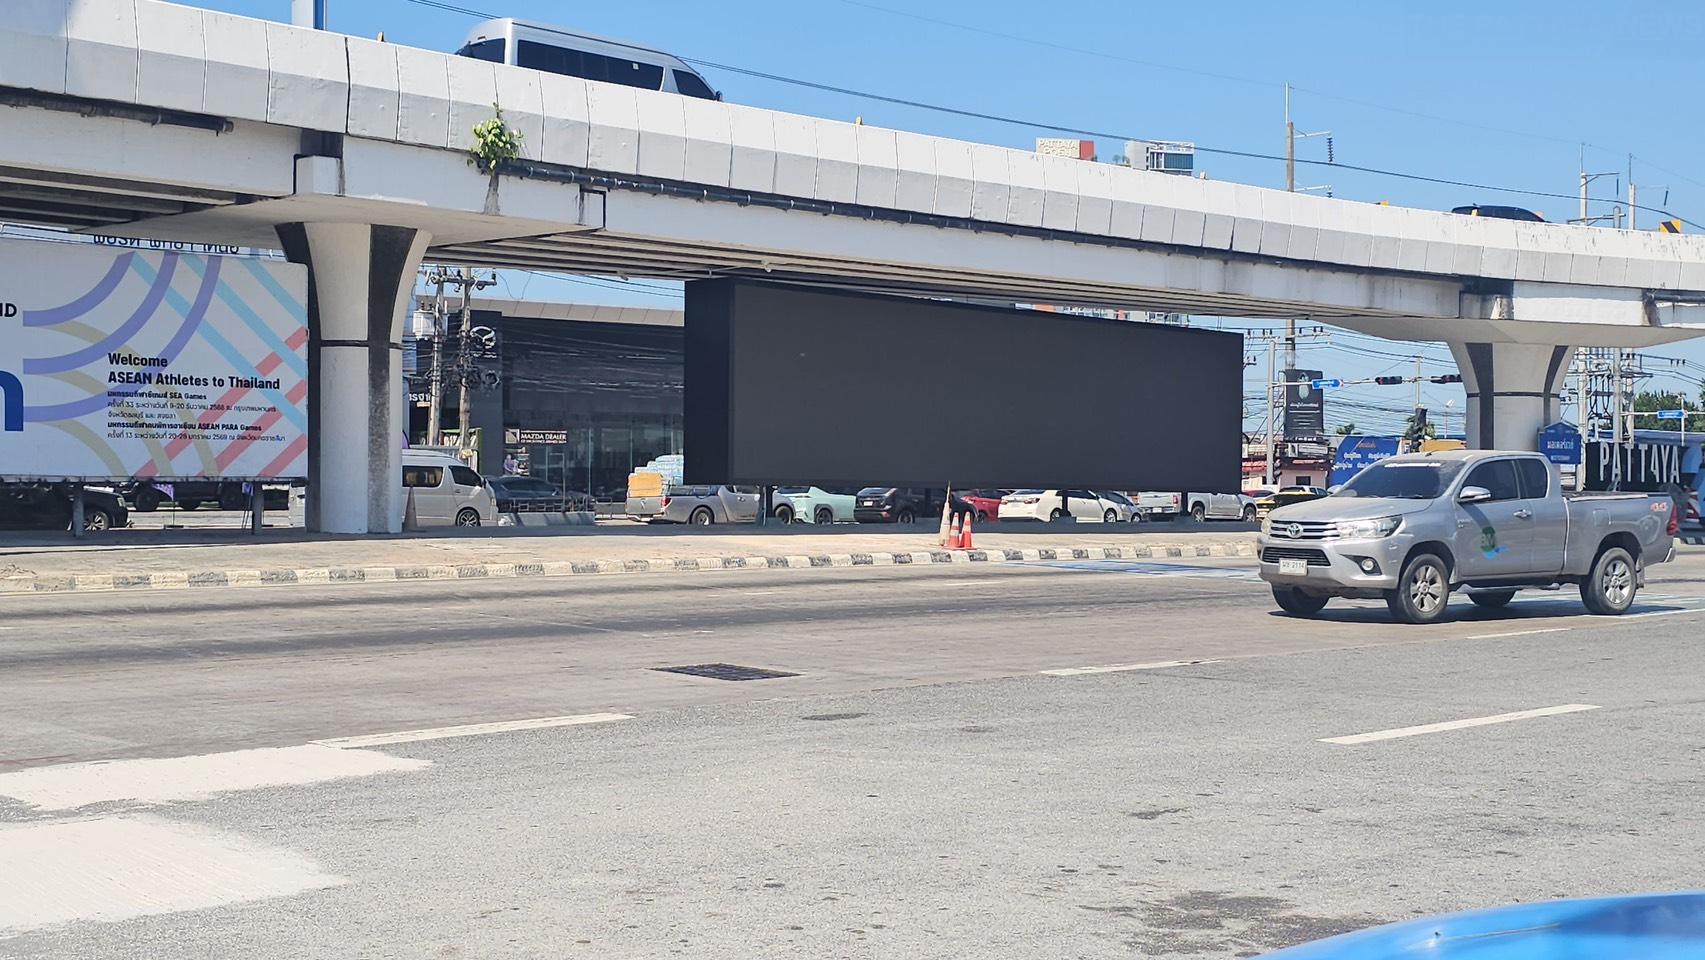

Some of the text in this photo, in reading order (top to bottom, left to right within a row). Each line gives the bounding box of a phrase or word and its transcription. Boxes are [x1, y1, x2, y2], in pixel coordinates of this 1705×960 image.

[107, 353, 168, 367] Welcome
[108, 371, 280, 390] ASEAN Athletes to Thailand
[169, 391, 183, 399] SEA
[198, 422, 220, 431] ASEAN
[221, 423, 238, 431] PARA
[240, 423, 262, 431] Games
